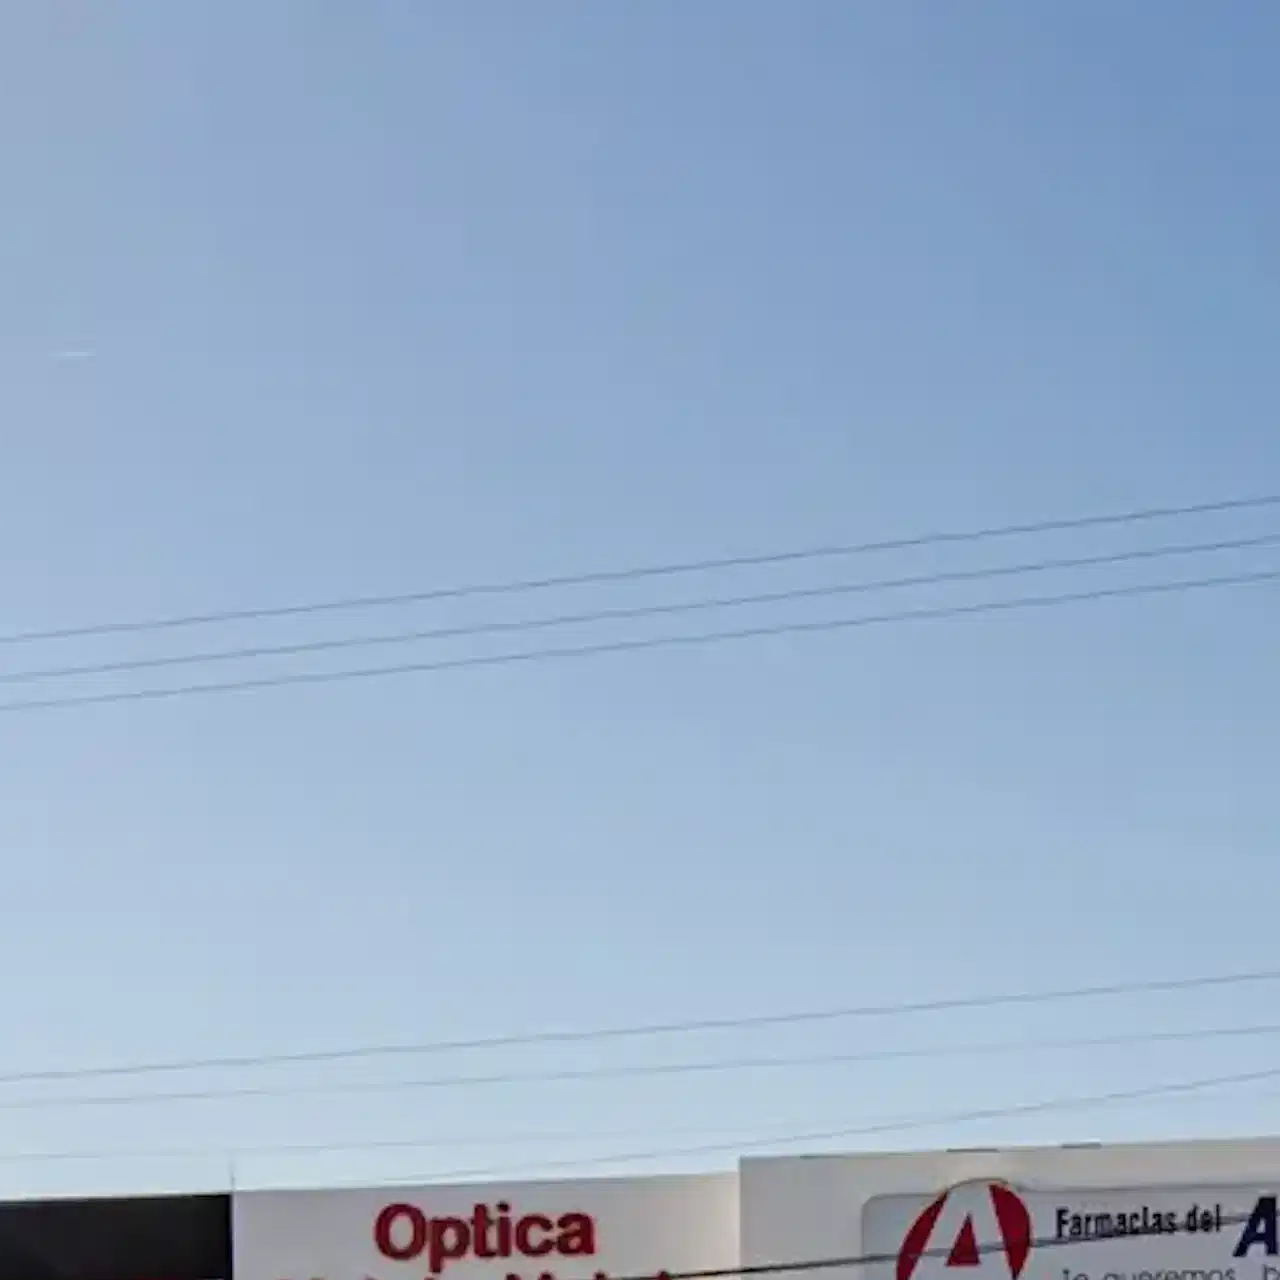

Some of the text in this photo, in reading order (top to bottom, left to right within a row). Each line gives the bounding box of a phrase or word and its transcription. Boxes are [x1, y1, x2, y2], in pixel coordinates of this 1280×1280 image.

[373, 1201, 596, 1274] Optica
[1055, 1203, 1222, 1243] Farmacias del
